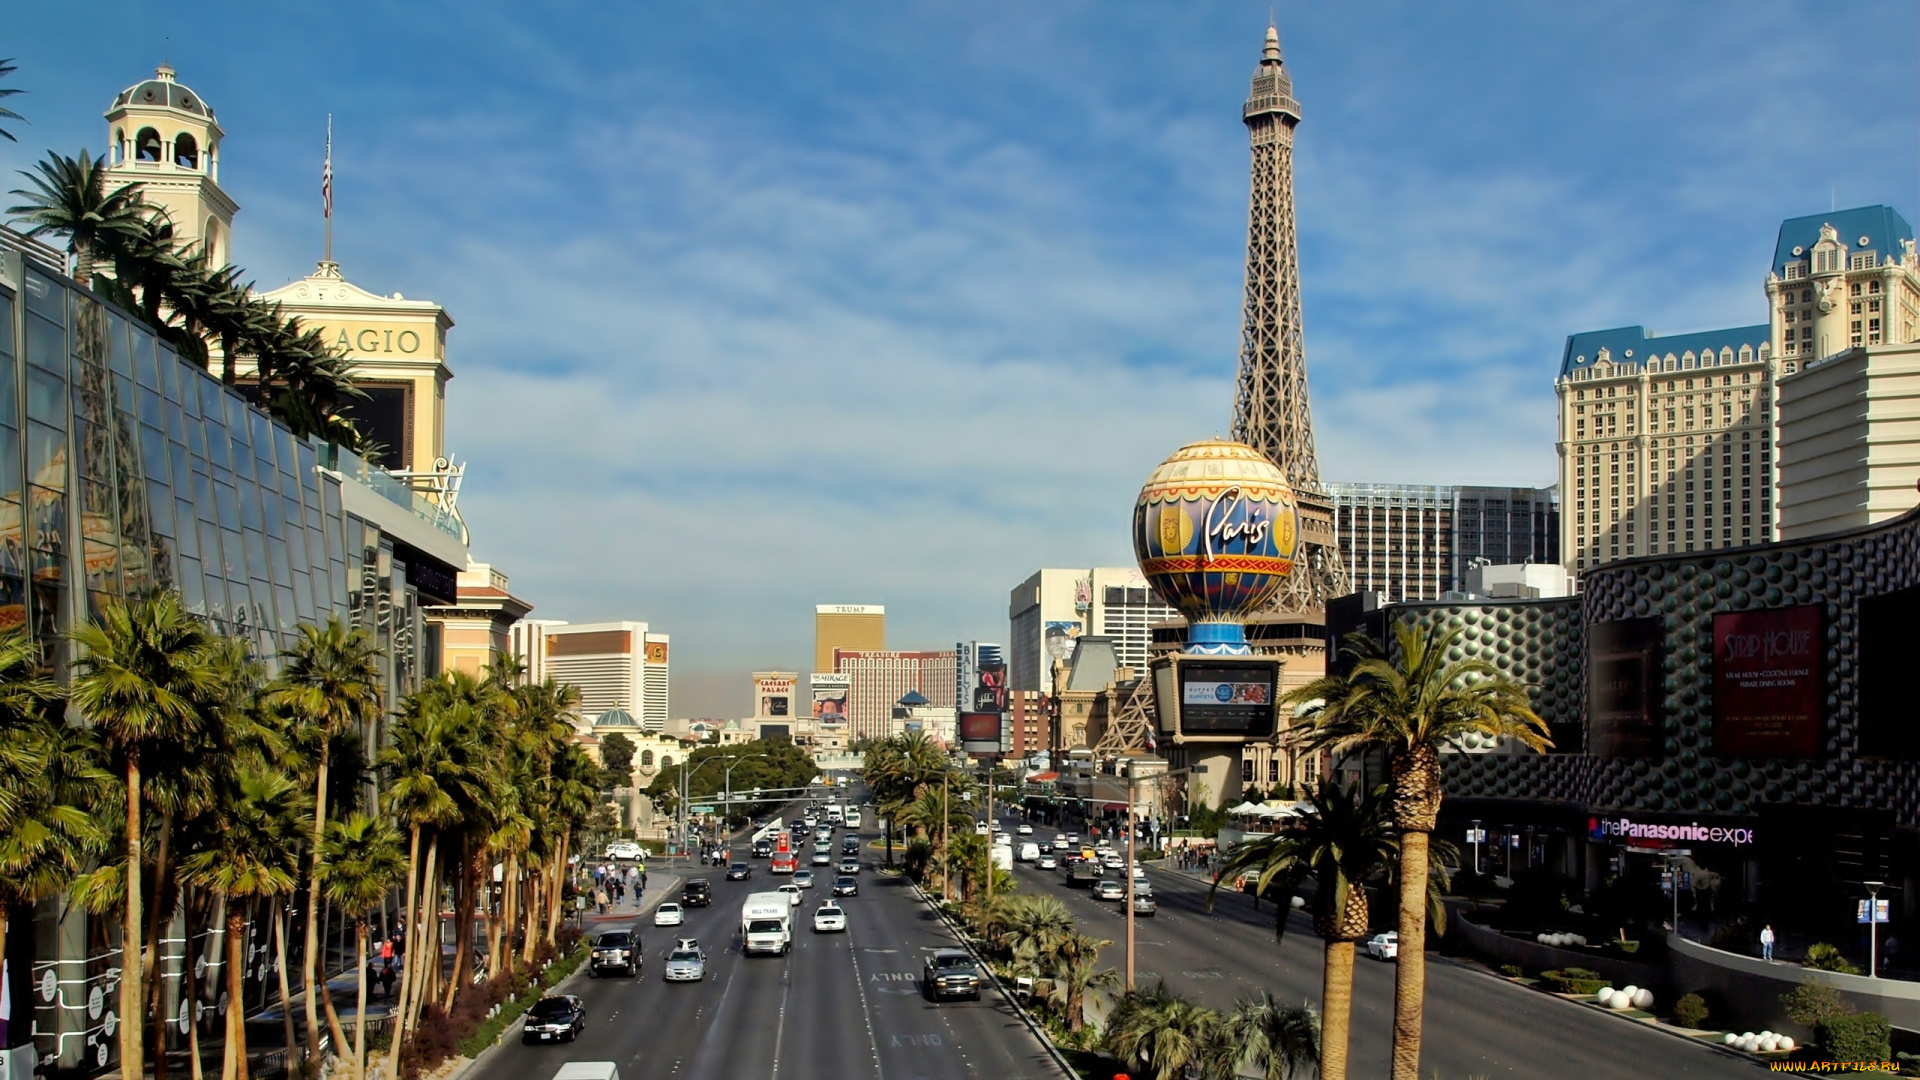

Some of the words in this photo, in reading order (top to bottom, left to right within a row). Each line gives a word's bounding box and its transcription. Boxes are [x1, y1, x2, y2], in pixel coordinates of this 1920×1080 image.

[1205, 485, 1269, 562] Paris
[1724, 634, 1760, 662] STRIP
[1763, 629, 1810, 663] HOUSE
[1742, 671, 1759, 679] HOUSE
[1789, 668, 1809, 677] LOUNGE
[1759, 680, 1776, 688] DINING
[1777, 679, 1796, 687] ROOMS
[871, 973, 915, 981] ONLY
[890, 1034, 941, 1047] ONLY
